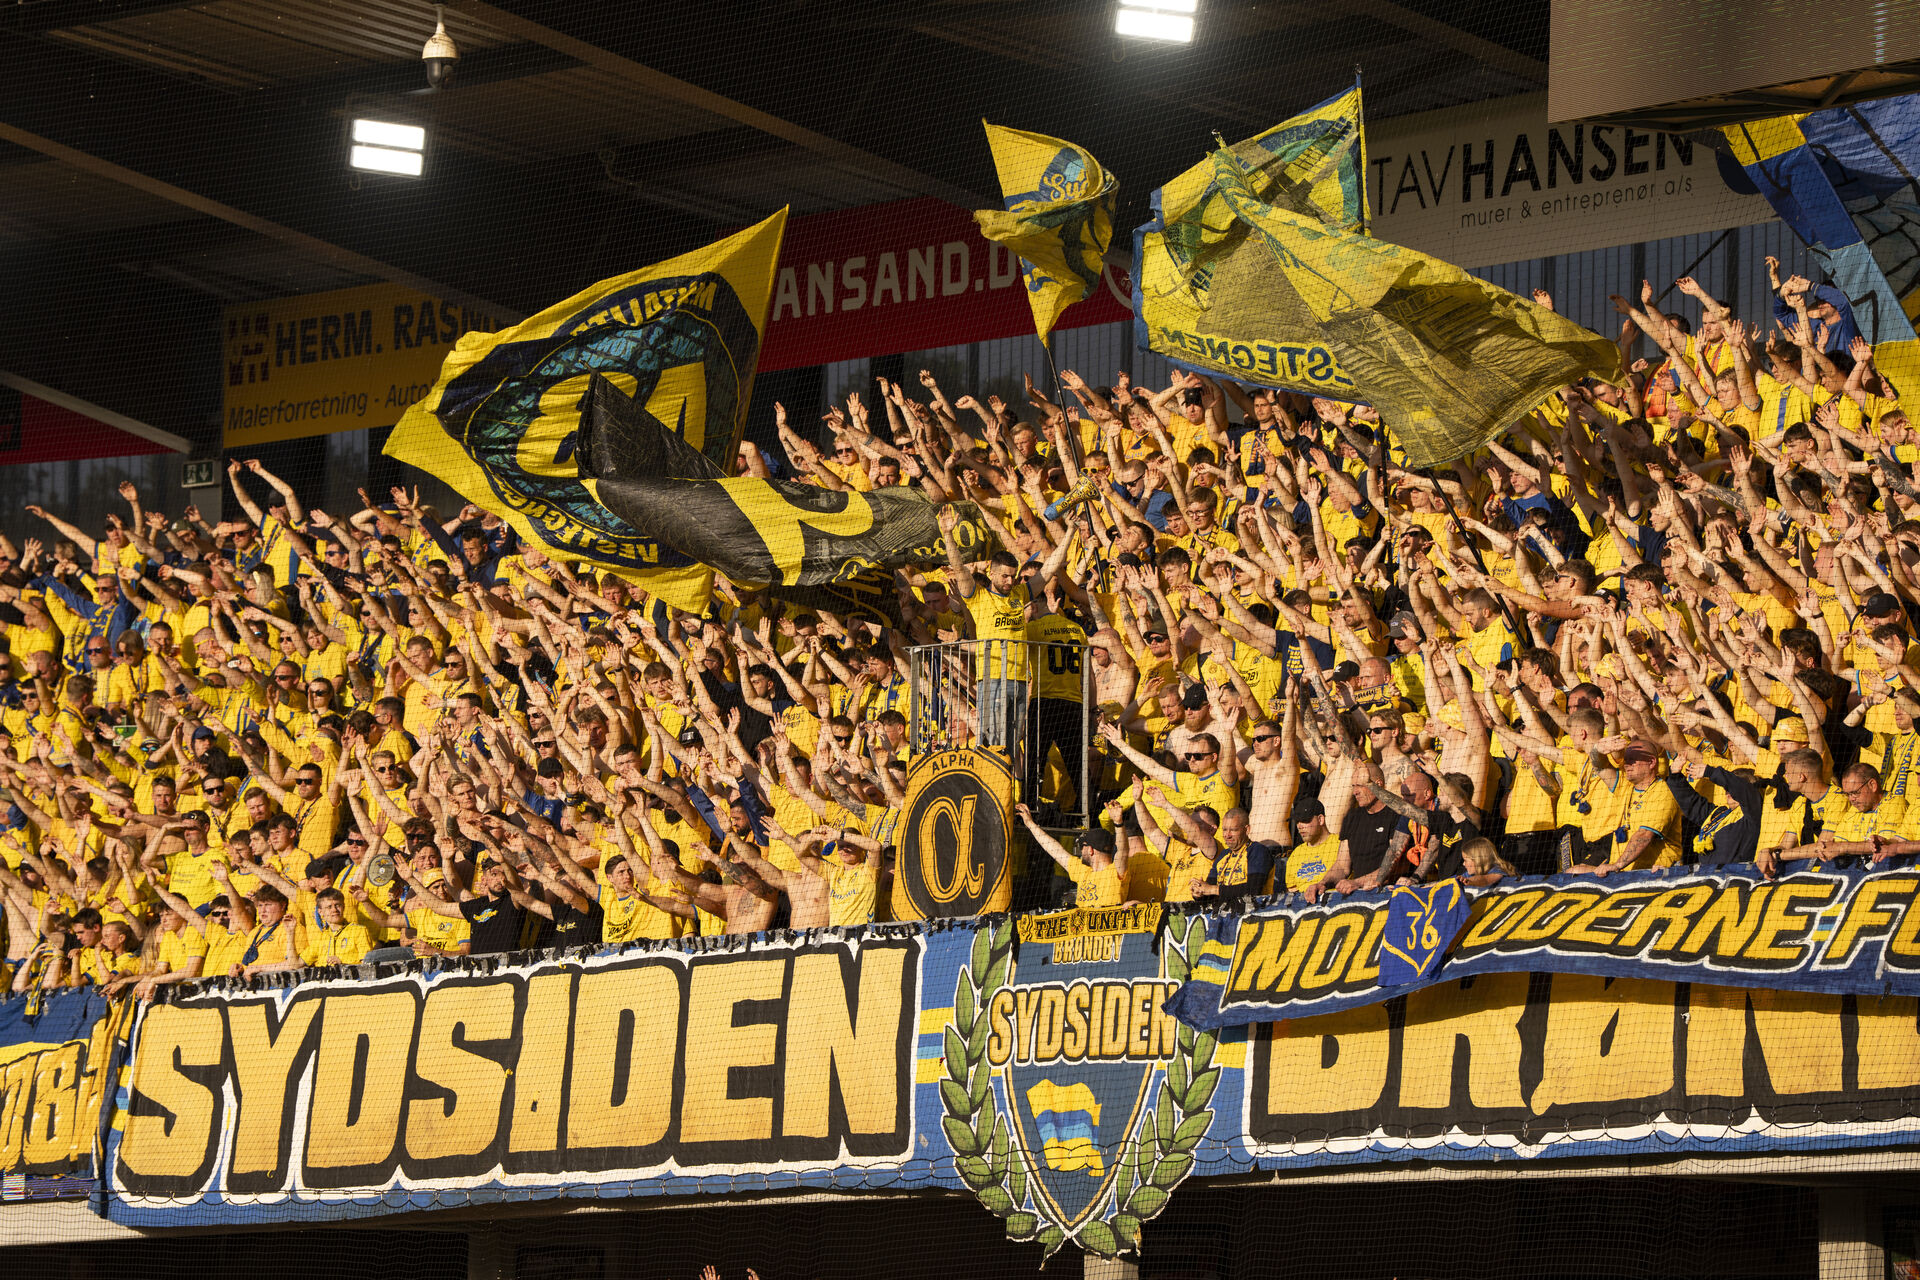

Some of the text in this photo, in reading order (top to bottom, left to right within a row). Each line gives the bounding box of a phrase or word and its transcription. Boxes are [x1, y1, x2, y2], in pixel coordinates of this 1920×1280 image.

[1461, 177, 1692, 228] murer & entreprenør a/s
[275, 308, 383, 367] HERM.
[228, 391, 369, 431] Malerforretning
[385, 379, 436, 408] Auto
[931, 755, 975, 776] ALPHA
[1034, 908, 1144, 939] THE UNITY
[1407, 911, 1439, 950] 36
[1053, 936, 1123, 964] BRØNDBY
[988, 982, 1180, 1065] SYDSIDEN
[118, 940, 920, 1198] SYDSIDEN
